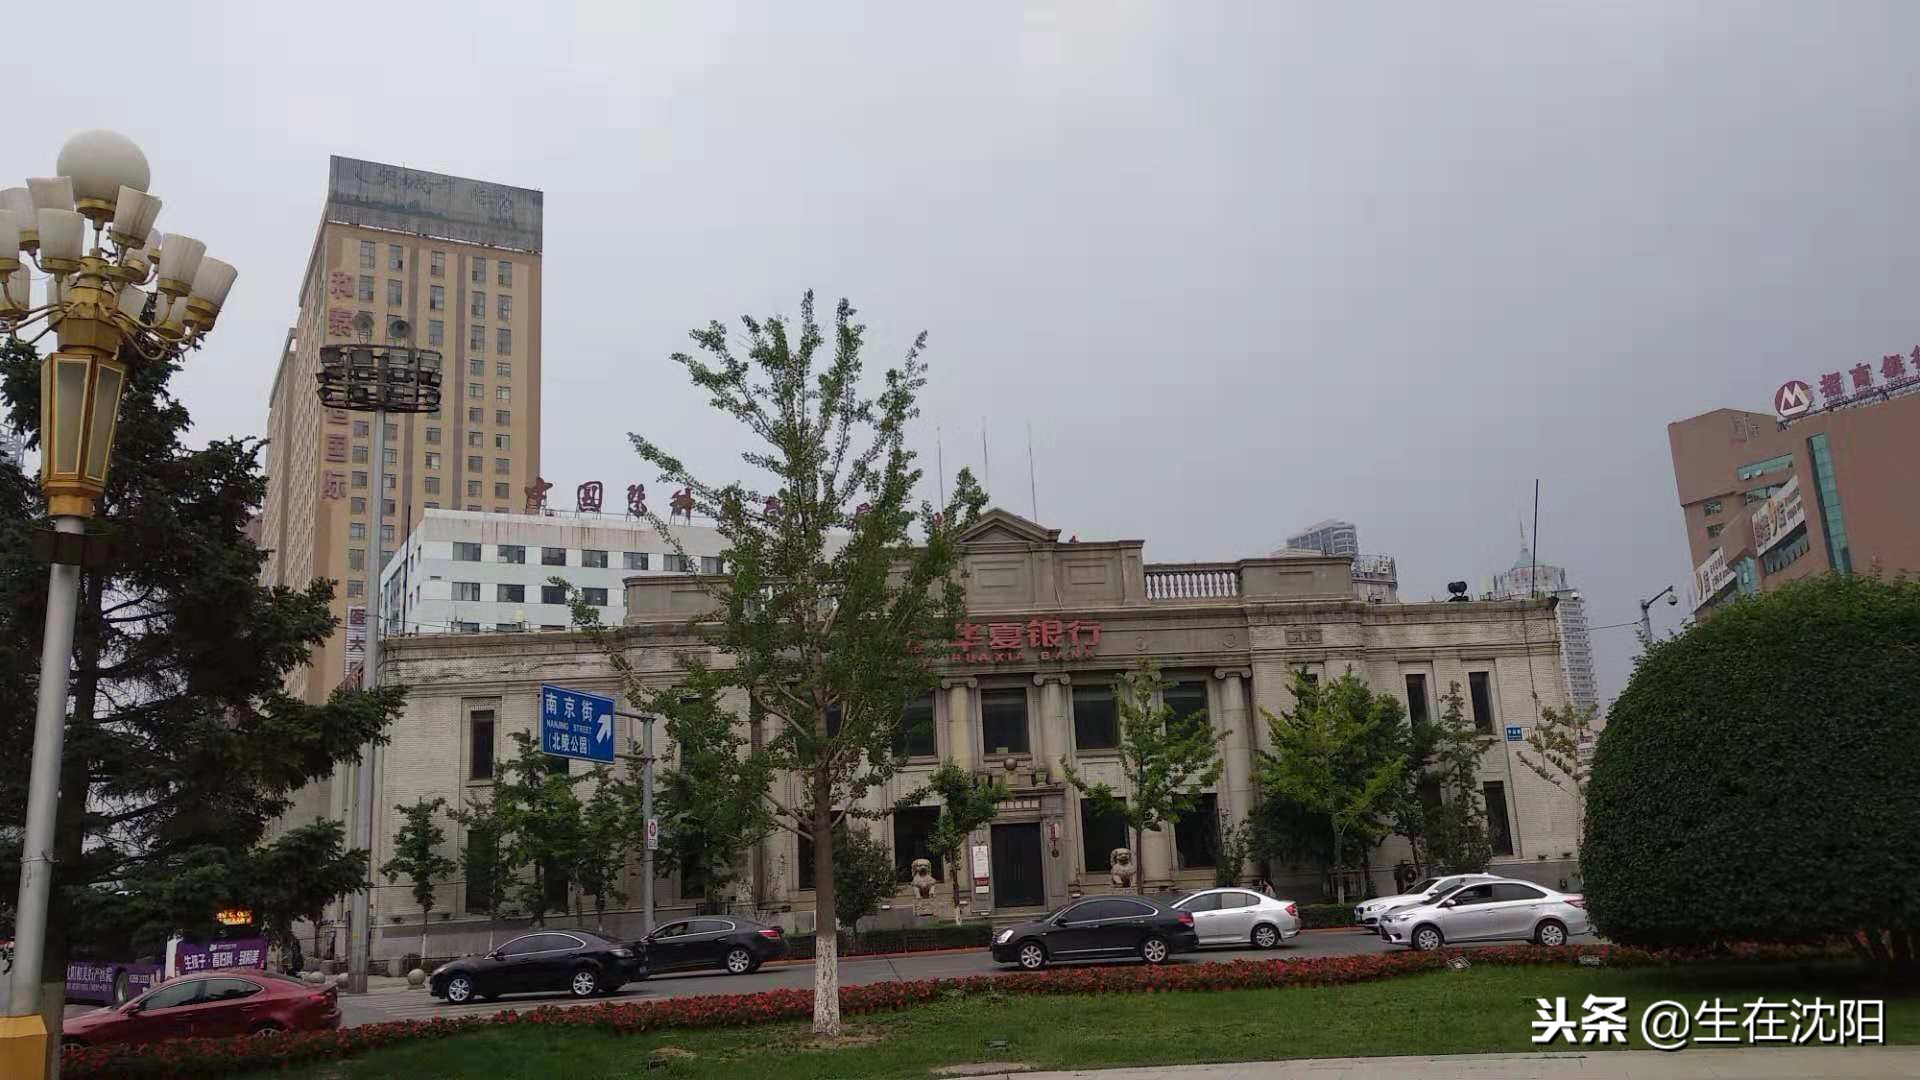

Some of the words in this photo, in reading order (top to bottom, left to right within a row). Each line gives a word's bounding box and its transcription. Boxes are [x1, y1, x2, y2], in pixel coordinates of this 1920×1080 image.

[949, 620, 1102, 651] 华夏银行
[545, 692, 593, 721] 南京街
[546, 720, 569, 730] NANJING
[573, 723, 592, 734] STREET
